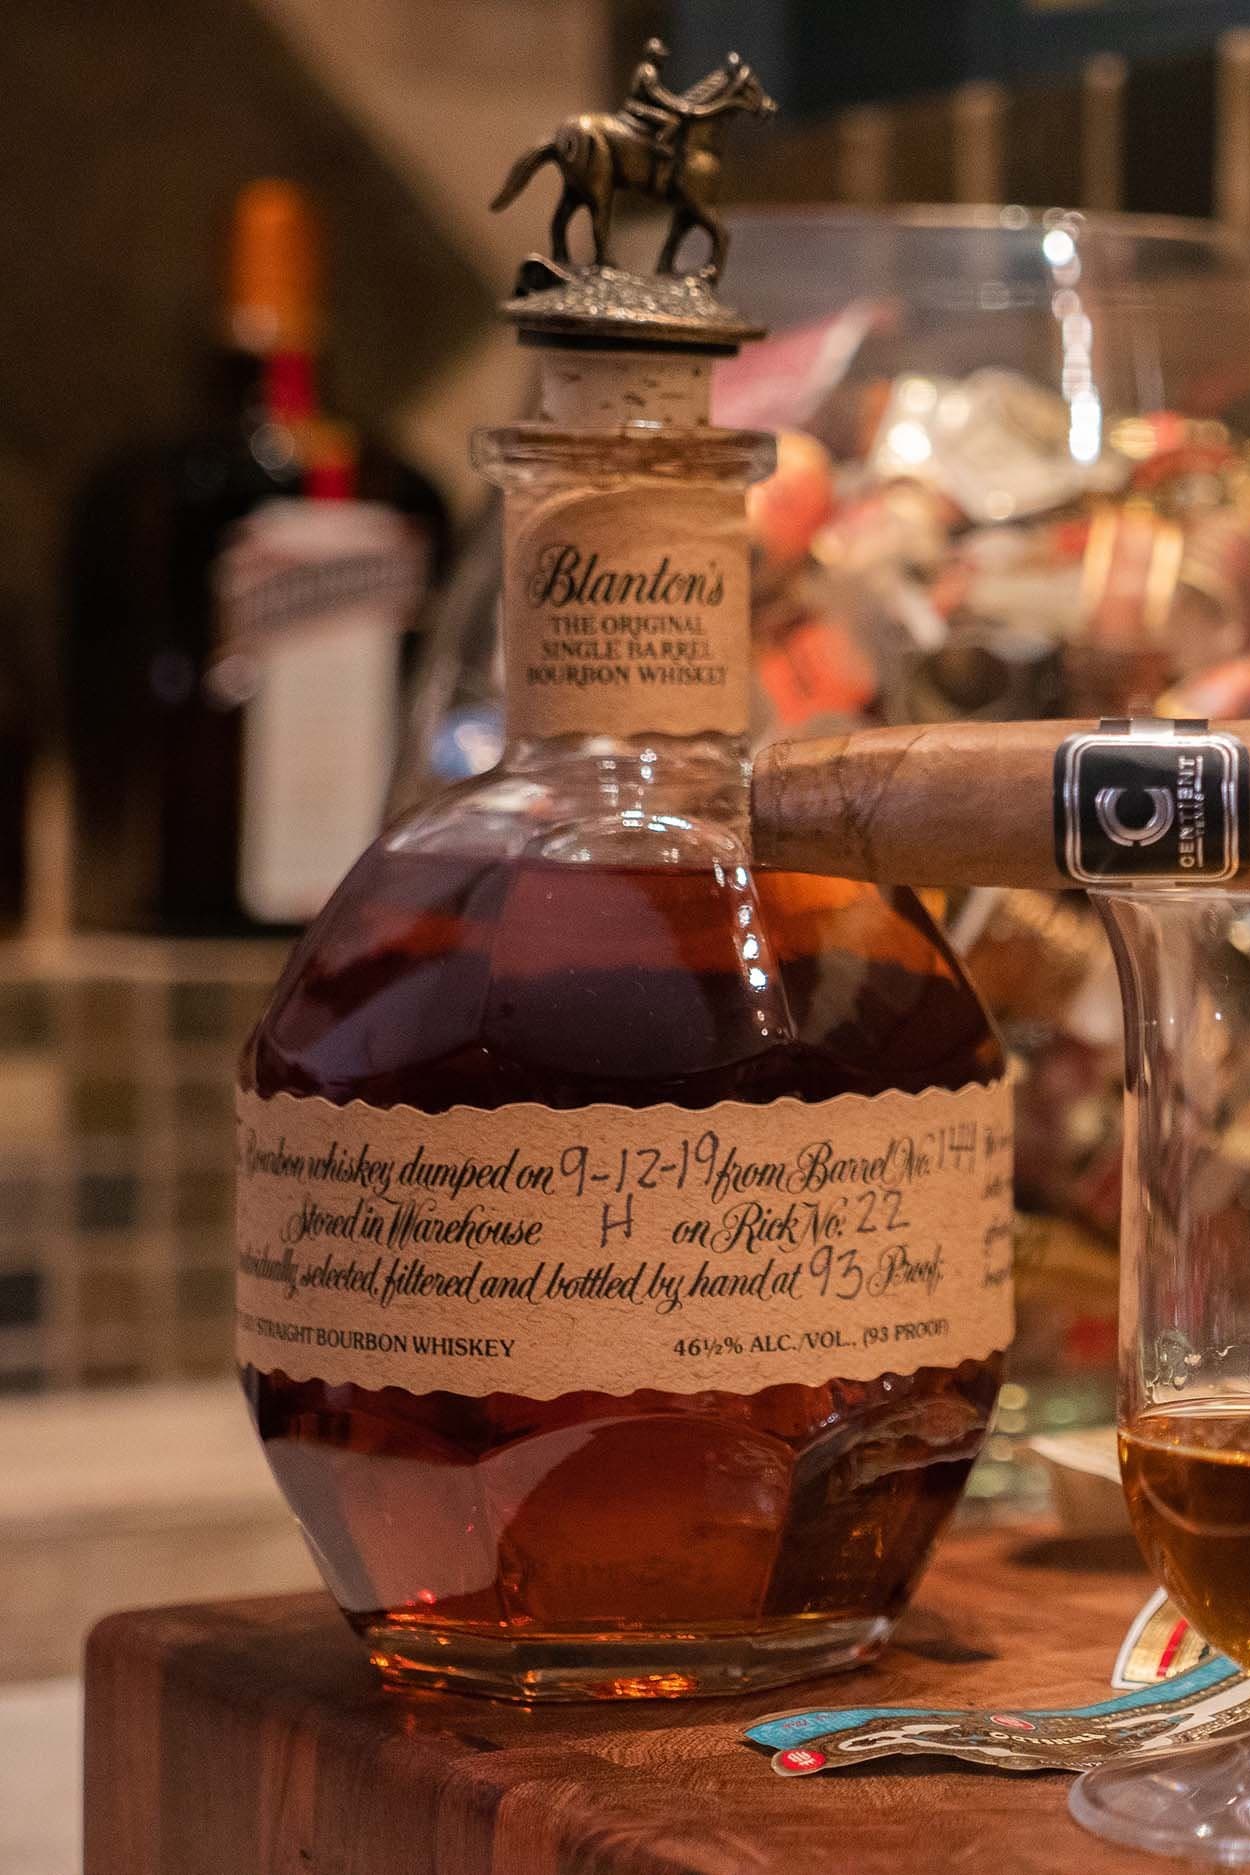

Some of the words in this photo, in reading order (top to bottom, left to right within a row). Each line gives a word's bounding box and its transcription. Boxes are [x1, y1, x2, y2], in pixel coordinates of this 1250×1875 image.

[527, 544, 726, 608] Blanton's
[550, 616, 596, 636] THE
[601, 615, 706, 639] ORIGINAL
[543, 639, 621, 660] SINGLE
[627, 641, 712, 661] BARREL
[527, 665, 631, 689] BOURBON
[638, 666, 729, 686] WHISKEY
[307, 1141, 394, 1197] whiskey
[399, 1145, 519, 1200] dumped
[515, 1165, 555, 1195] on
[712, 1146, 786, 1204] from
[787, 1139, 897, 1194] Barrel
[359, 1206, 385, 1246] in
[383, 1198, 543, 1250] Warehouse
[600, 1193, 634, 1248] H
[671, 1218, 712, 1246] on
[711, 1201, 801, 1254] Rick
[856, 1190, 911, 1233] 22
[378, 1257, 482, 1308] filtered
[480, 1260, 544, 1305] and
[544, 1261, 646, 1305] bottled
[649, 1262, 687, 1314] by
[688, 1260, 775, 1301] hand
[770, 1262, 803, 1300] at
[809, 1245, 864, 1300] 93
[256, 1317, 314, 1346] STRAIGHT
[315, 1327, 408, 1353] BOURBON
[411, 1334, 516, 1358] WHISKEY
[863, 1325, 890, 1349] (93
